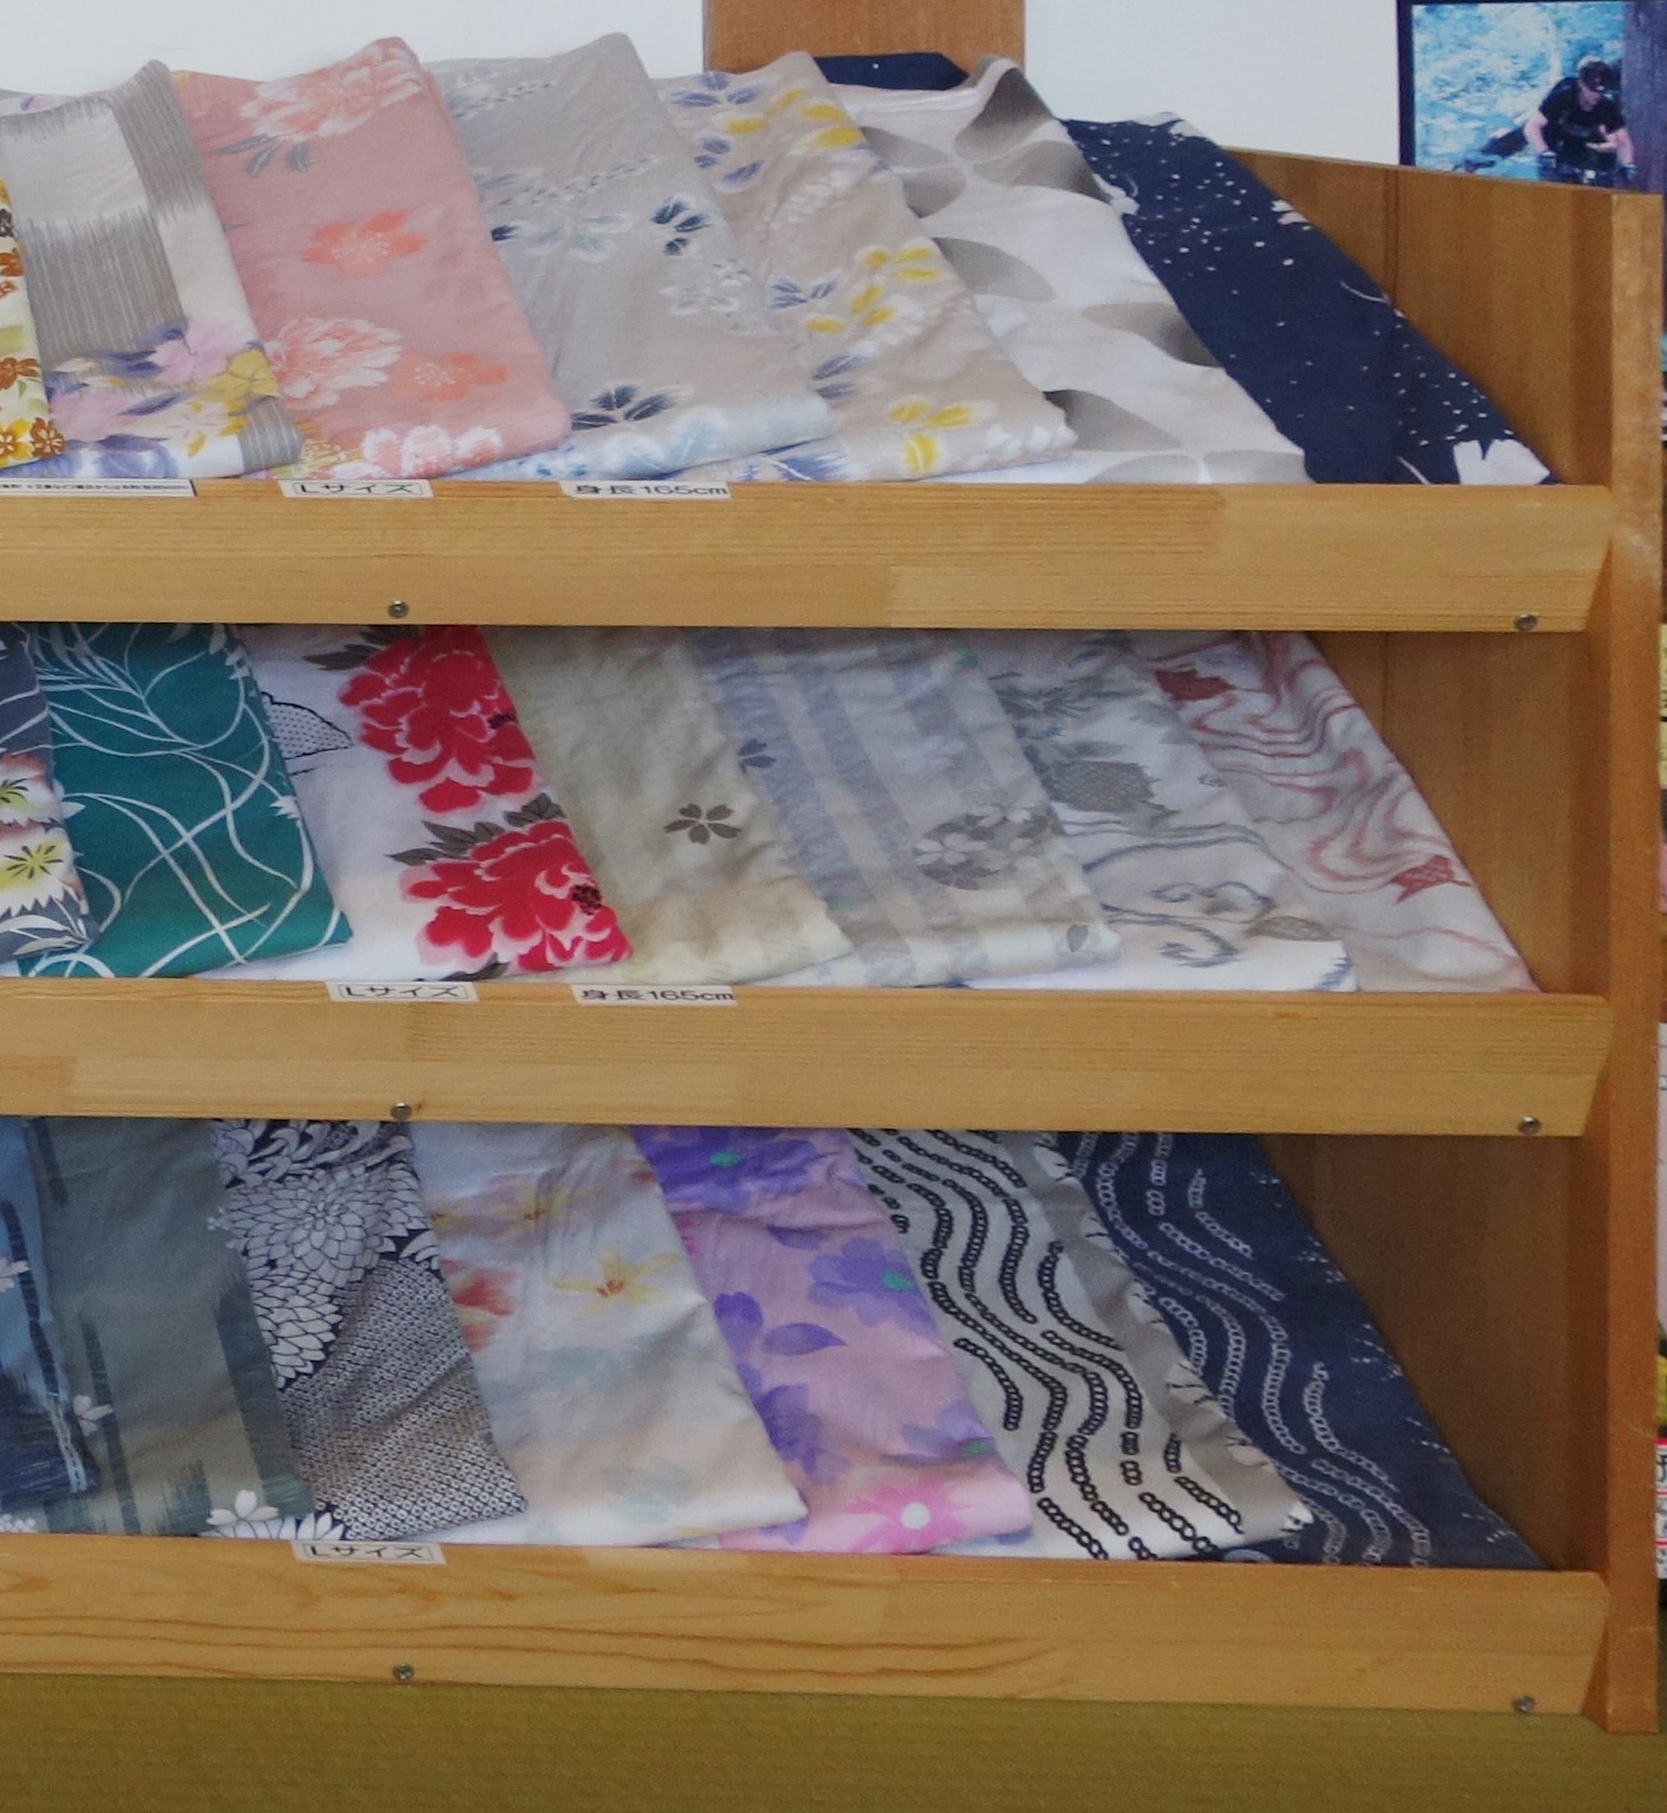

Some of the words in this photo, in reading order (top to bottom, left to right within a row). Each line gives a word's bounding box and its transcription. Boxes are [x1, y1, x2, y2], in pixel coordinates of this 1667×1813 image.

[299, 483, 414, 495] Lサイズ
[345, 986, 460, 998] Lサイズ
[581, 989, 735, 1002] 身長165cm
[311, 1544, 422, 1558] Lサイズ
